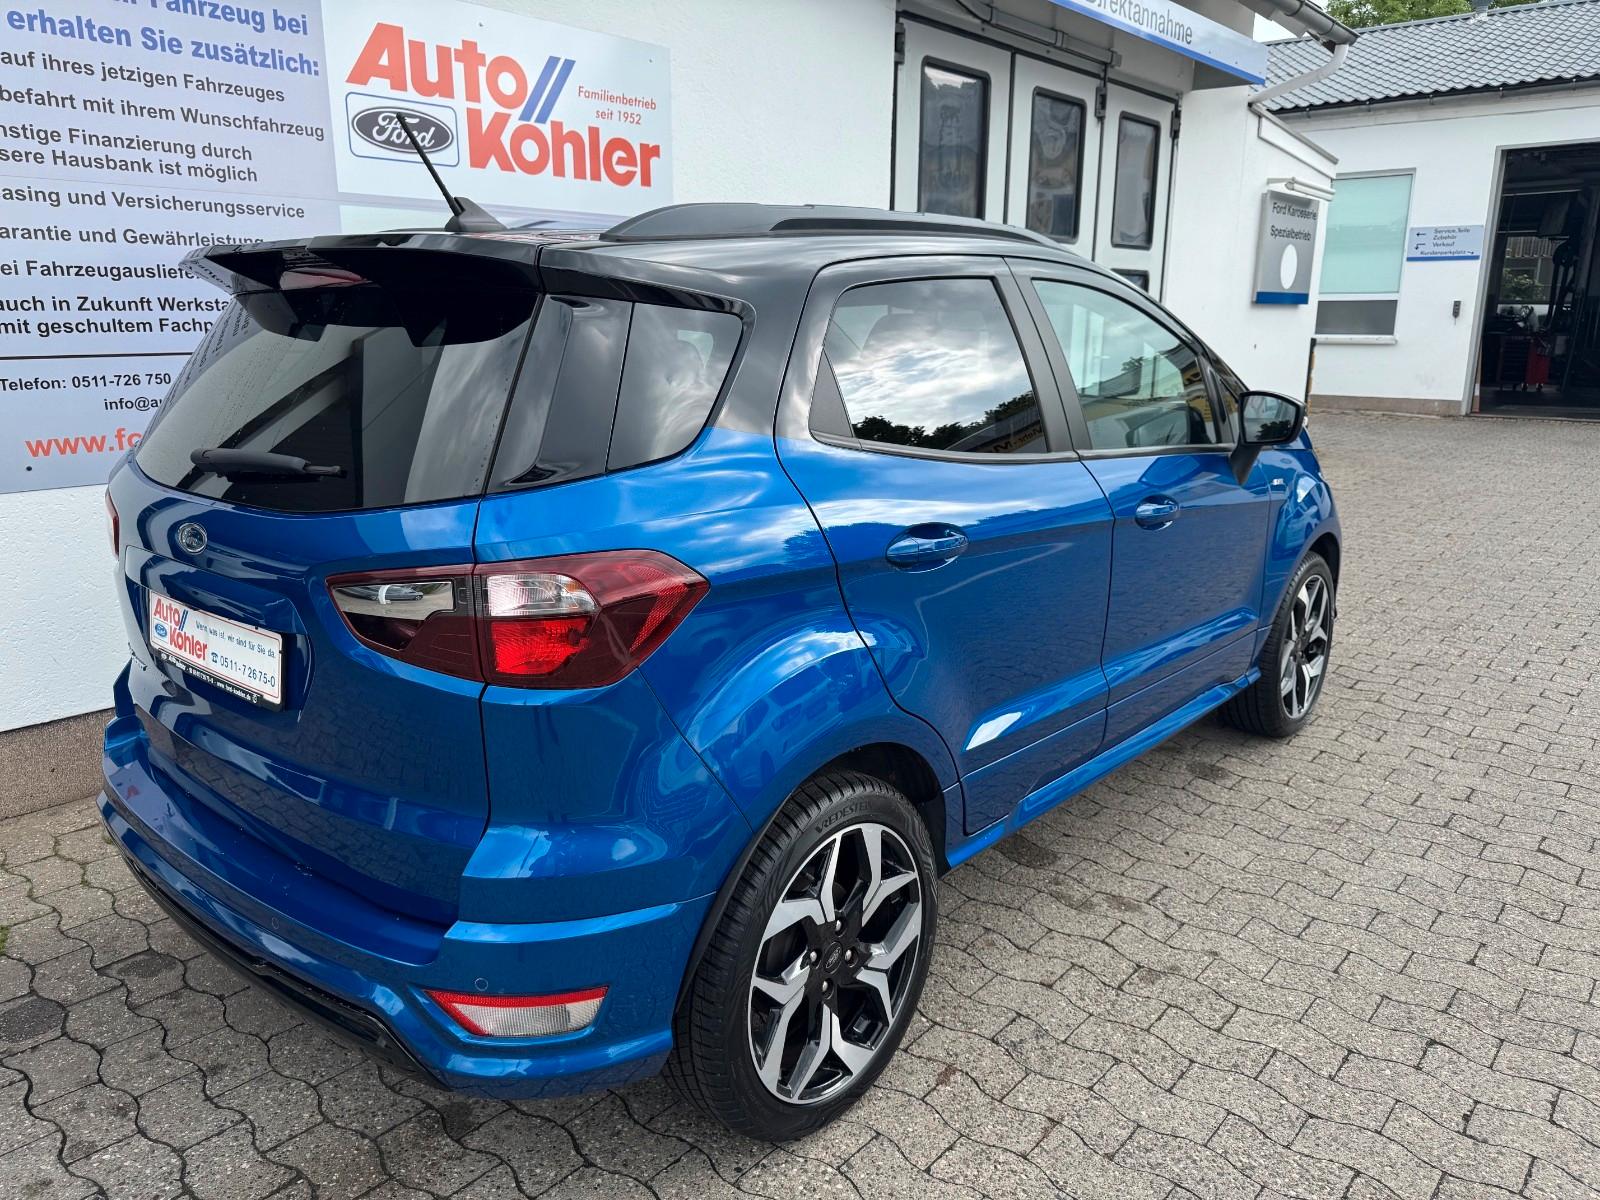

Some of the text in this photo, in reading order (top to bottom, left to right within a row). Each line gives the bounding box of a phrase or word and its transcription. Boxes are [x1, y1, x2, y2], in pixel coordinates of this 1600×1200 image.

[272, 9, 309, 36] bei
[6, 9, 320, 77] erhalten Sie zusätzlich:
[41, 53, 96, 76] ihres
[100, 62, 178, 89] jetzigen
[183, 74, 286, 103] Fahrzeuges
[345, 22, 529, 109] Auto
[577, 85, 658, 111] Familienbetrieb
[82, 98, 116, 115] mit
[120, 99, 176, 122] ihrem
[180, 107, 326, 142] Wunschfahrzeug
[372, 112, 436, 148] Ford
[595, 108, 642, 126] seit 1952
[68, 128, 197, 159] Finanzierung
[201, 143, 253, 162] durch
[51, 150, 154, 174] Hausbank
[158, 160, 183, 177] ist
[187, 164, 258, 184] möglich
[2, 185, 306, 220] asing und Versicherungsservice
[1272, 201, 1317, 222] Ford Karosserie
[78, 227, 117, 244] und
[1270, 224, 1311, 241] Spezialbetrieb
[0, 259, 19, 276] ei
[52, 295, 70, 312] in
[77, 296, 154, 313] Zukunft
[37, 318, 153, 338] geschultem
[1, 372, 171, 392] Telefon: 0511-726 750
[153, 597, 181, 627] Auto
[236, 635, 247, 648] sind
[257, 642, 266, 656] Sie
